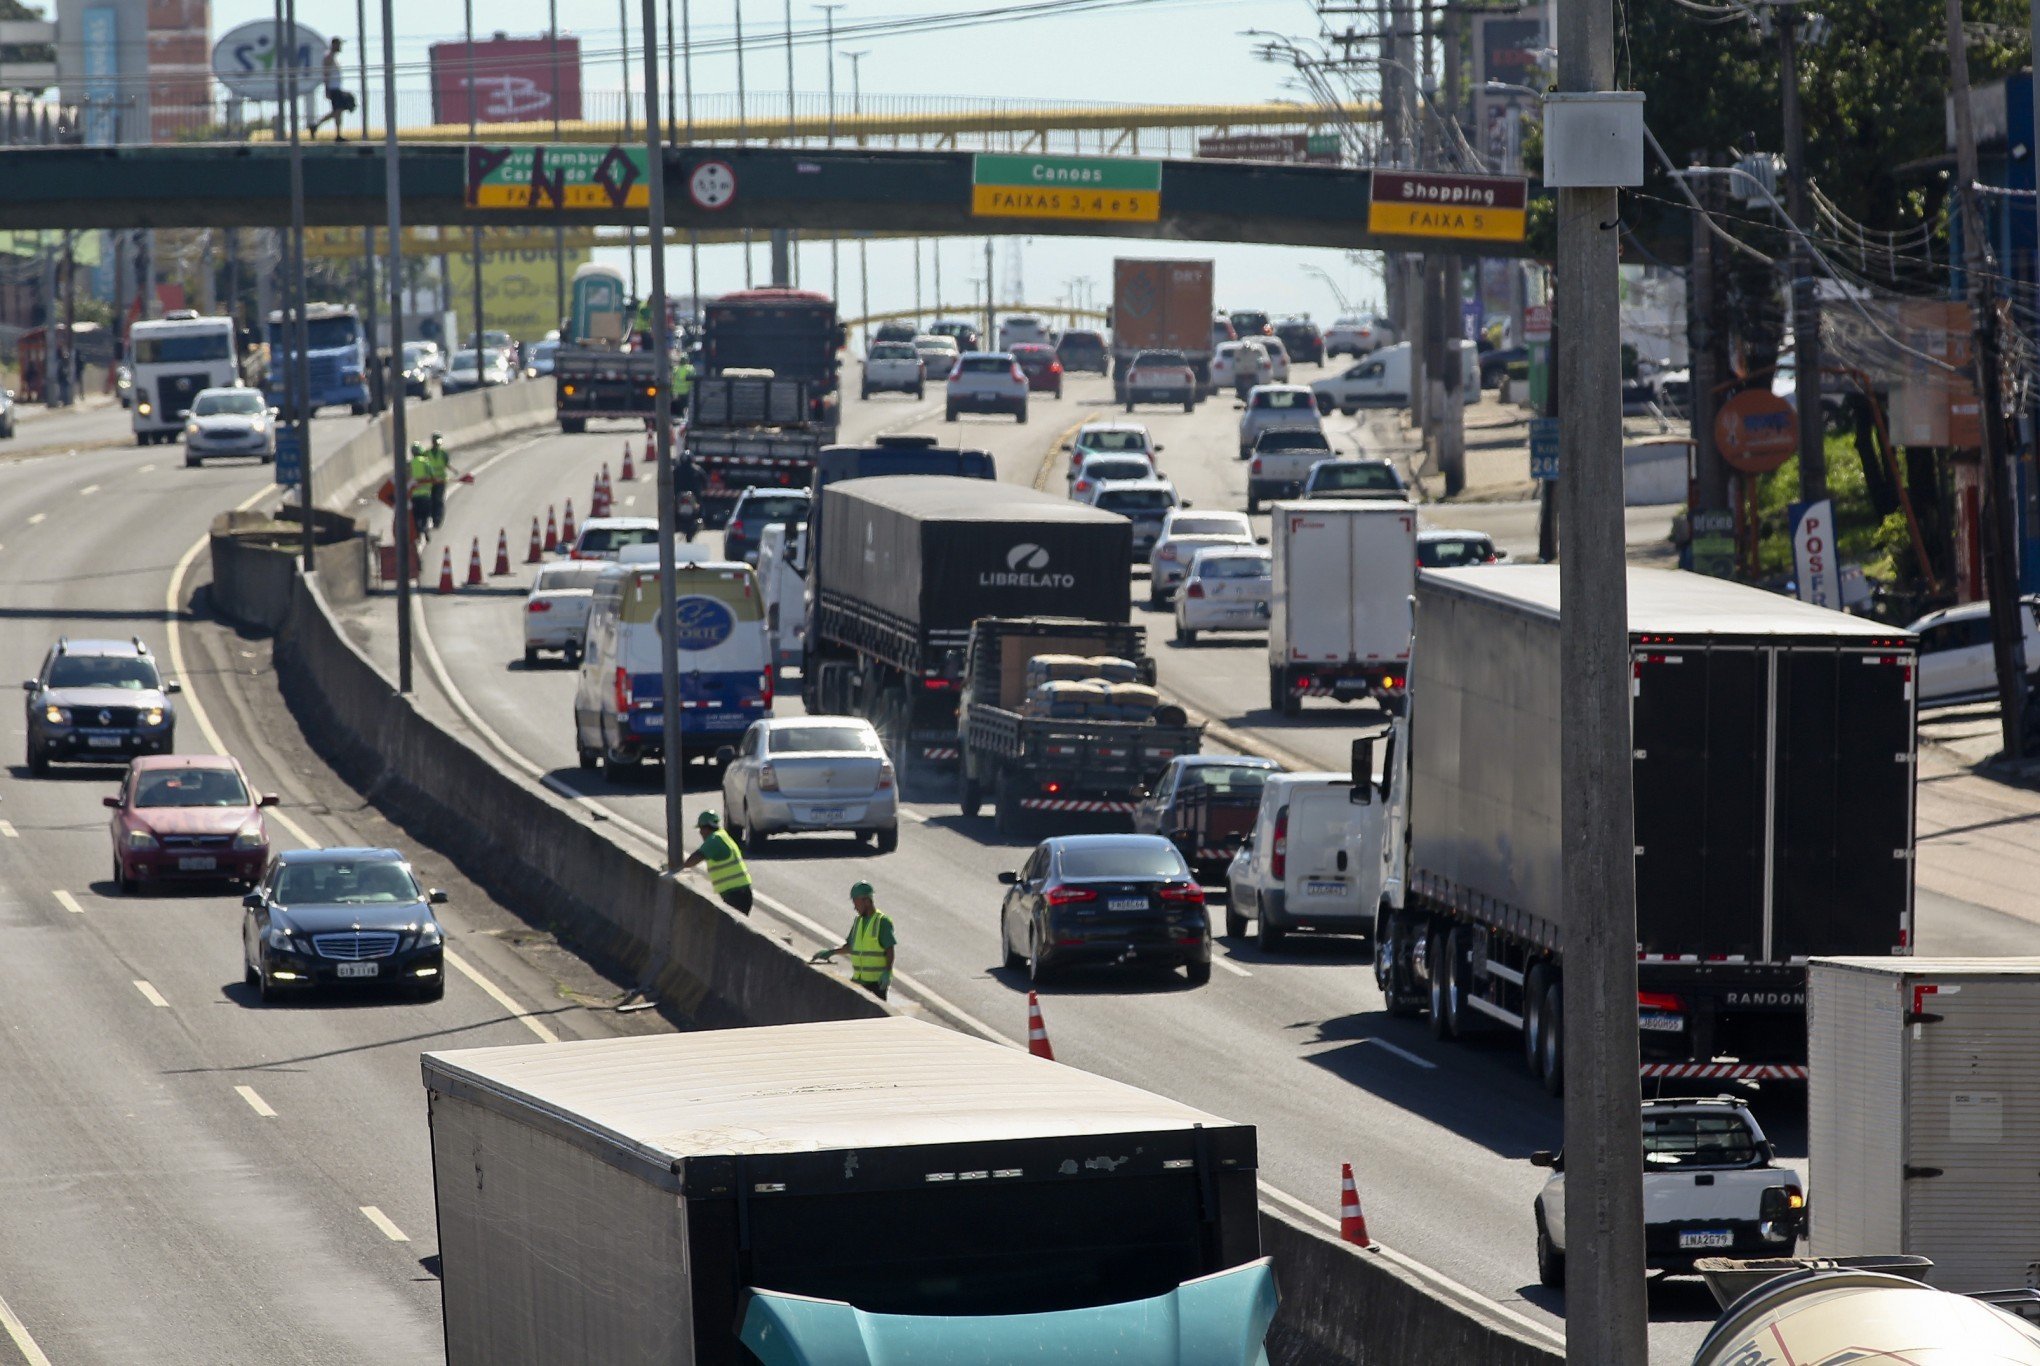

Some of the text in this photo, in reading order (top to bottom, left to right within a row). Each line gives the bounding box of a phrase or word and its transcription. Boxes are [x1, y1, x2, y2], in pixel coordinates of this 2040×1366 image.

[1032, 164, 1102, 181] Canoas
[1402, 181, 1495, 206] Shopping
[993, 194, 1061, 209] FAIXAS
[1092, 197, 1101, 210] 4
[1111, 199, 1120, 210] e
[1129, 198, 1139, 212] 5
[1410, 211, 1484, 229] FAIXA 5
[980, 572, 1075, 588] LIBRELATO
[1727, 993, 1805, 1005] RANDON
